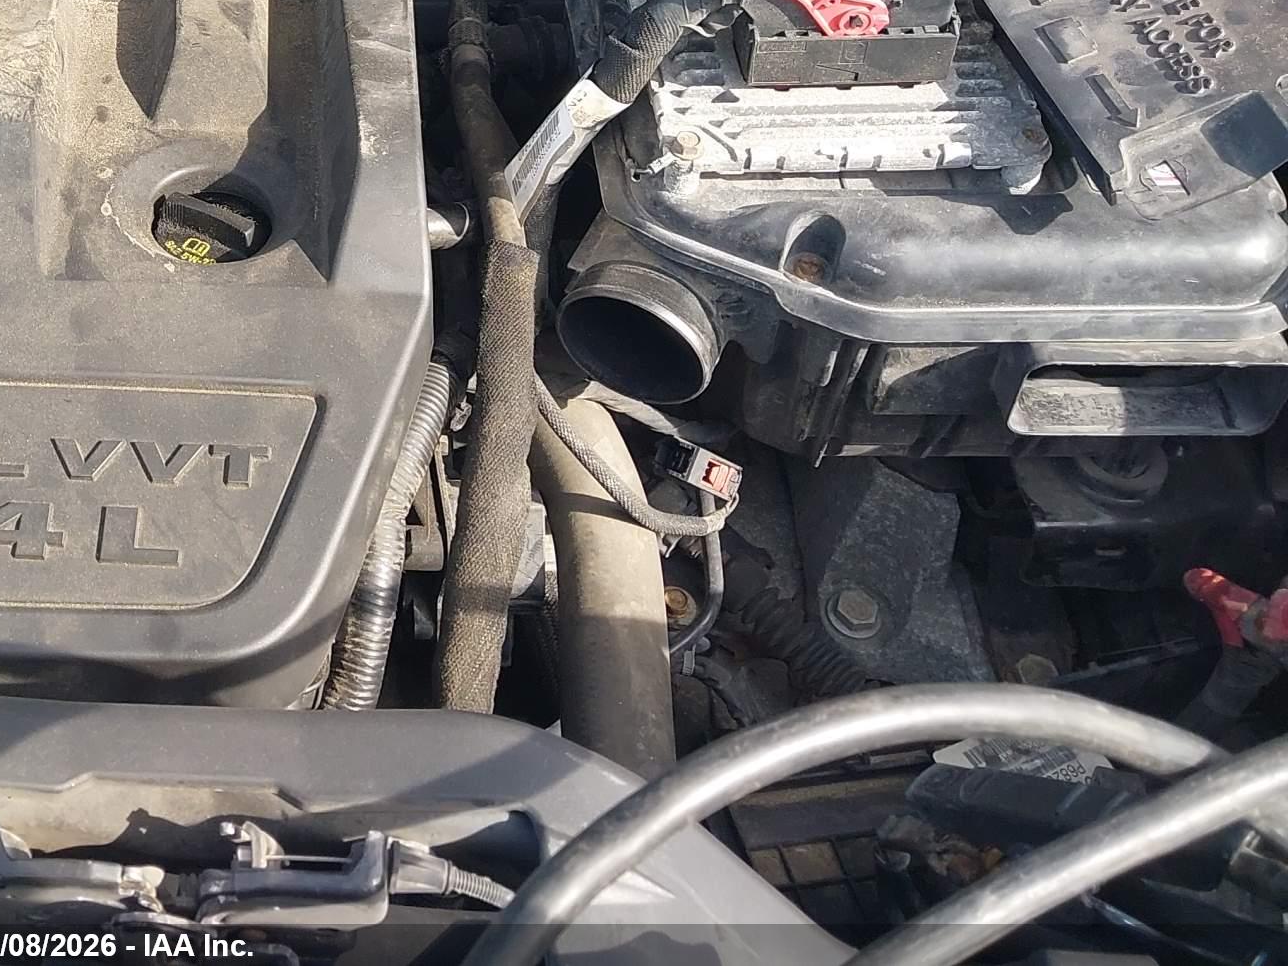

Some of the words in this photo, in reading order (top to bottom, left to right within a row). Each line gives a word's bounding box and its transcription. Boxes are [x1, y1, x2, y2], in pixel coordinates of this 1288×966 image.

[1124, 16, 1214, 97] ACCESS
[1176, 12, 1236, 60] FOR
[51, 436, 272, 489] VVT
